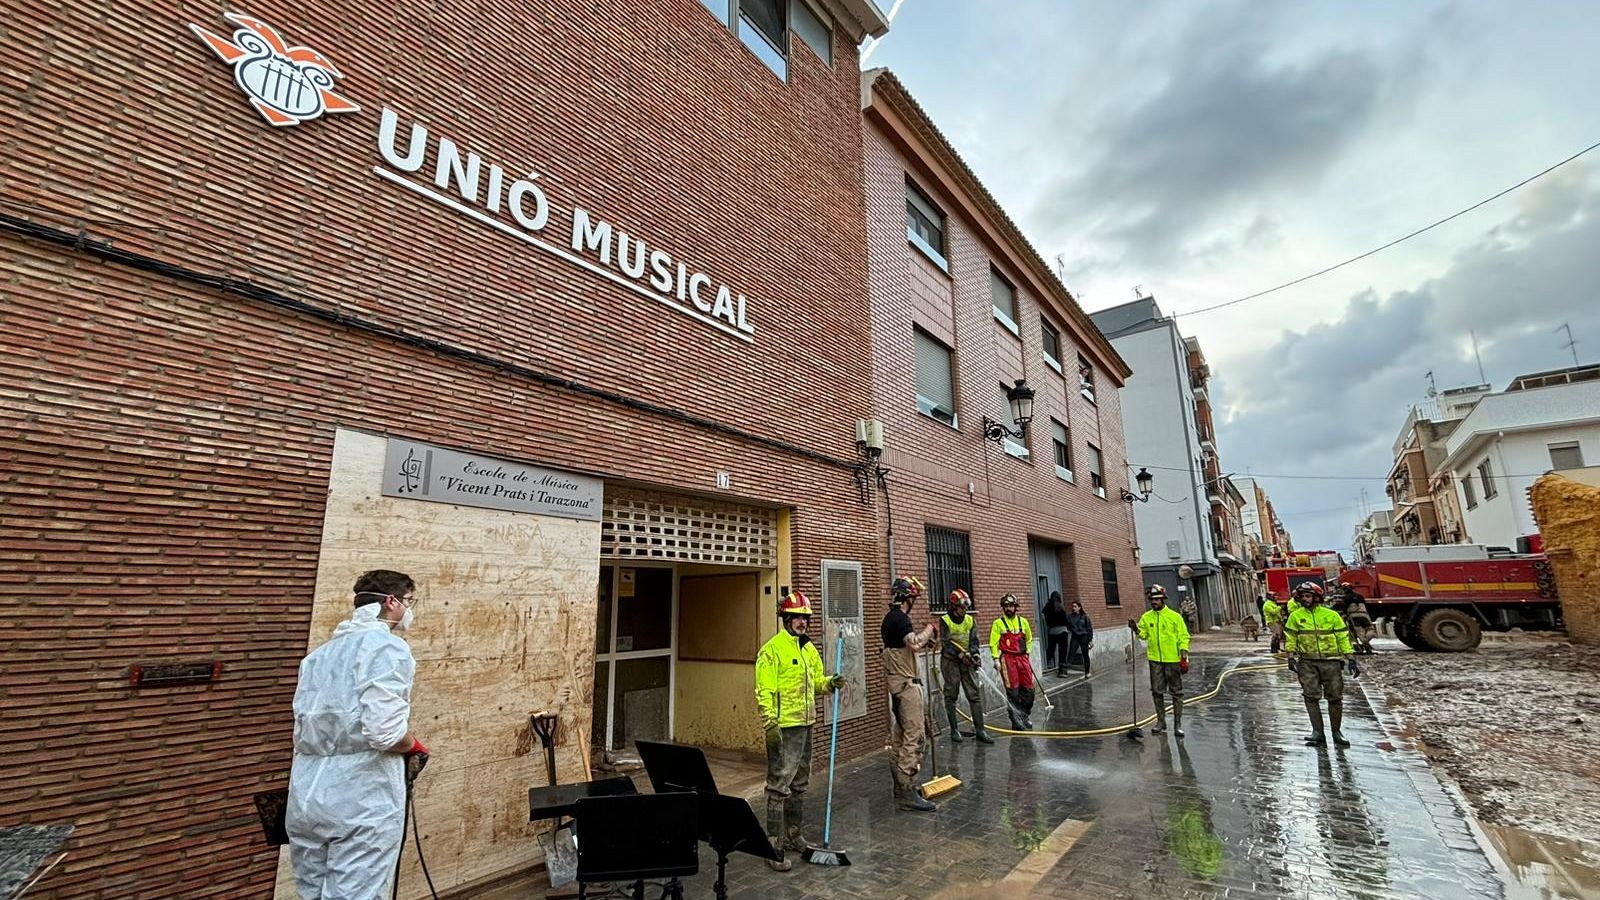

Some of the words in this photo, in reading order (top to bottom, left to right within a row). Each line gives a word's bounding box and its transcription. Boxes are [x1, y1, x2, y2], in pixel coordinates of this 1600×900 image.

[377, 107, 549, 232] UNIÓ
[571, 207, 755, 335] MUSICAL
[439, 475, 491, 497] "Vicent
[492, 484, 528, 502] Prats
[529, 489, 535, 502] i
[537, 490, 595, 509] Tarazona"
[463, 461, 507, 480] Escola
[513, 470, 529, 483] de
[533, 474, 580, 491] Música
[718, 474, 728, 487] 17
